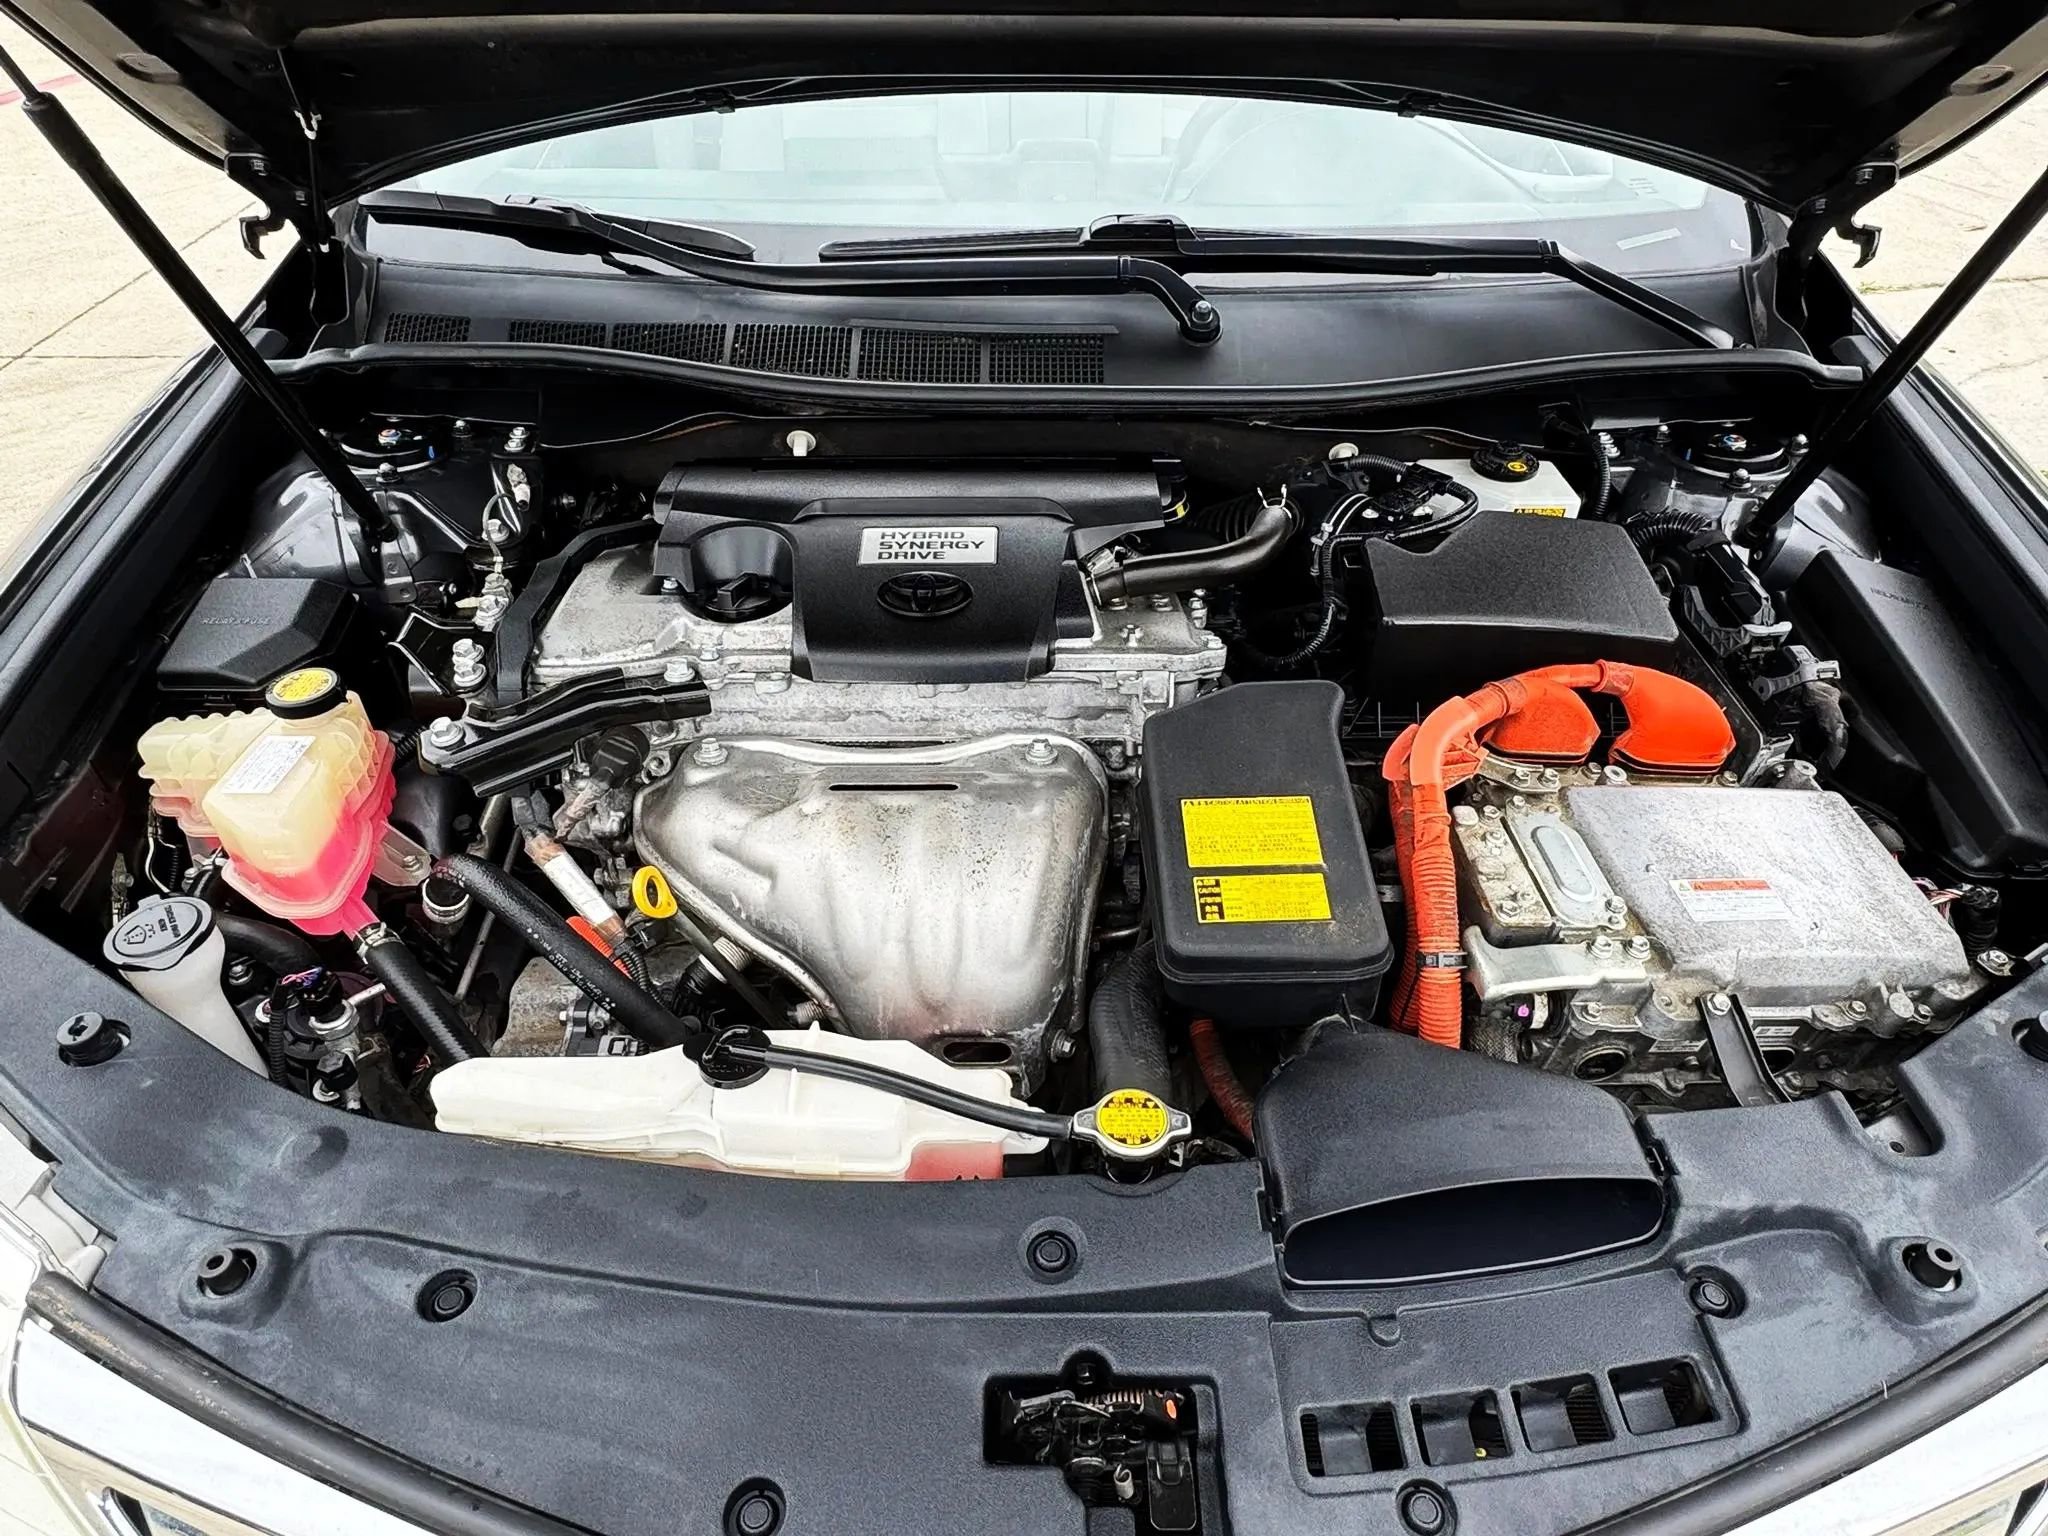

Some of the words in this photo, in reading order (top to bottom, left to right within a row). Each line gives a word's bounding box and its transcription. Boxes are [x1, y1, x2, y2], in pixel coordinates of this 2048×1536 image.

[880, 531, 965, 540] HYBRID
[879, 540, 985, 550] SYNERGY
[877, 551, 946, 560] DRIVE
